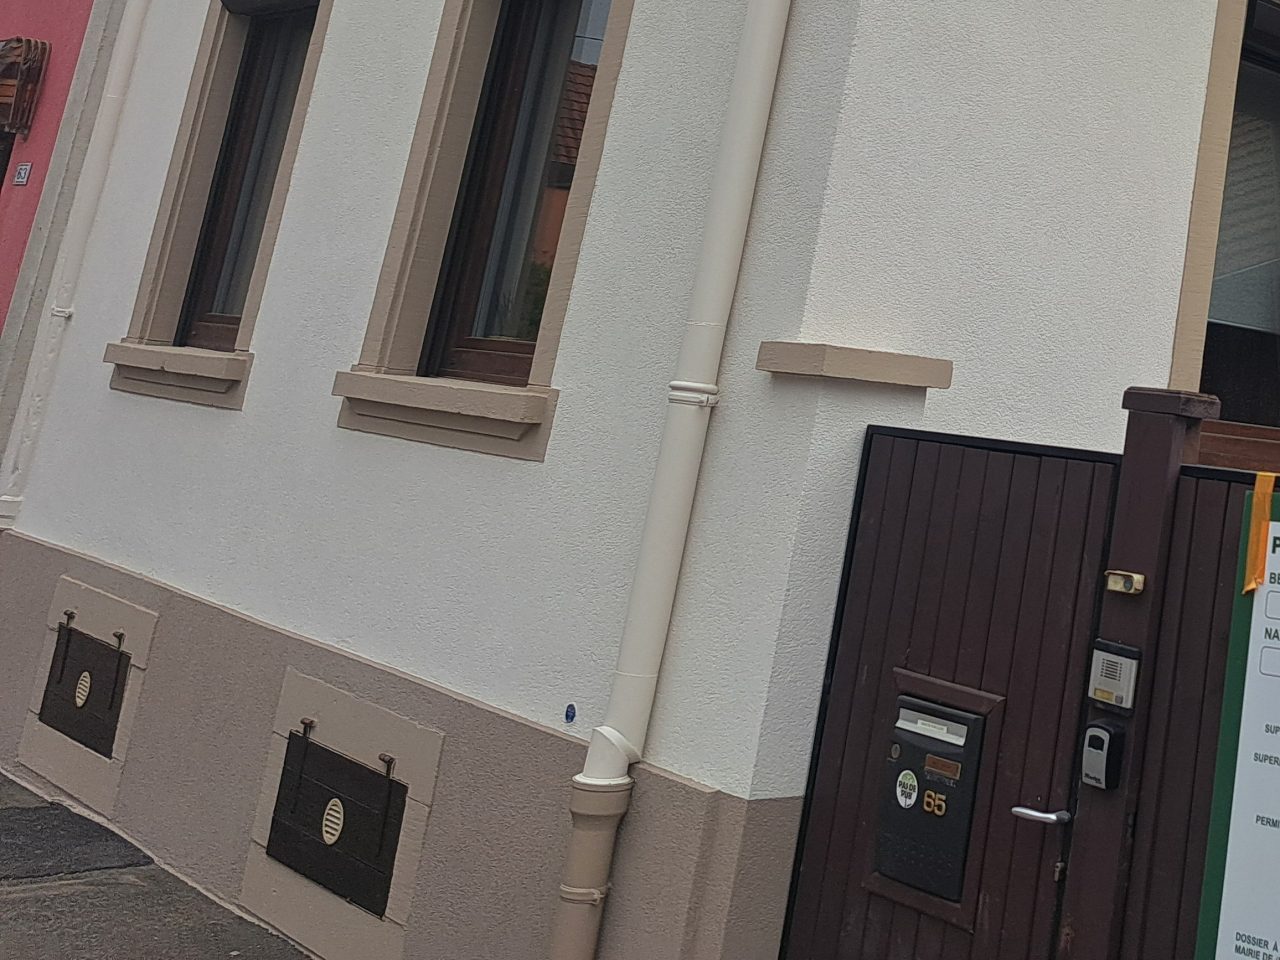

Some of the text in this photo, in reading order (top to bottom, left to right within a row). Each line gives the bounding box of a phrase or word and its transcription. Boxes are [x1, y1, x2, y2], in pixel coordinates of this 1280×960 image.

[901, 790, 913, 800] PUB
[909, 783, 917, 793] DE
[923, 789, 947, 817] 65
[1235, 931, 1269, 950] DOSSIER
[1234, 944, 1273, 960] MAIRIE DE
